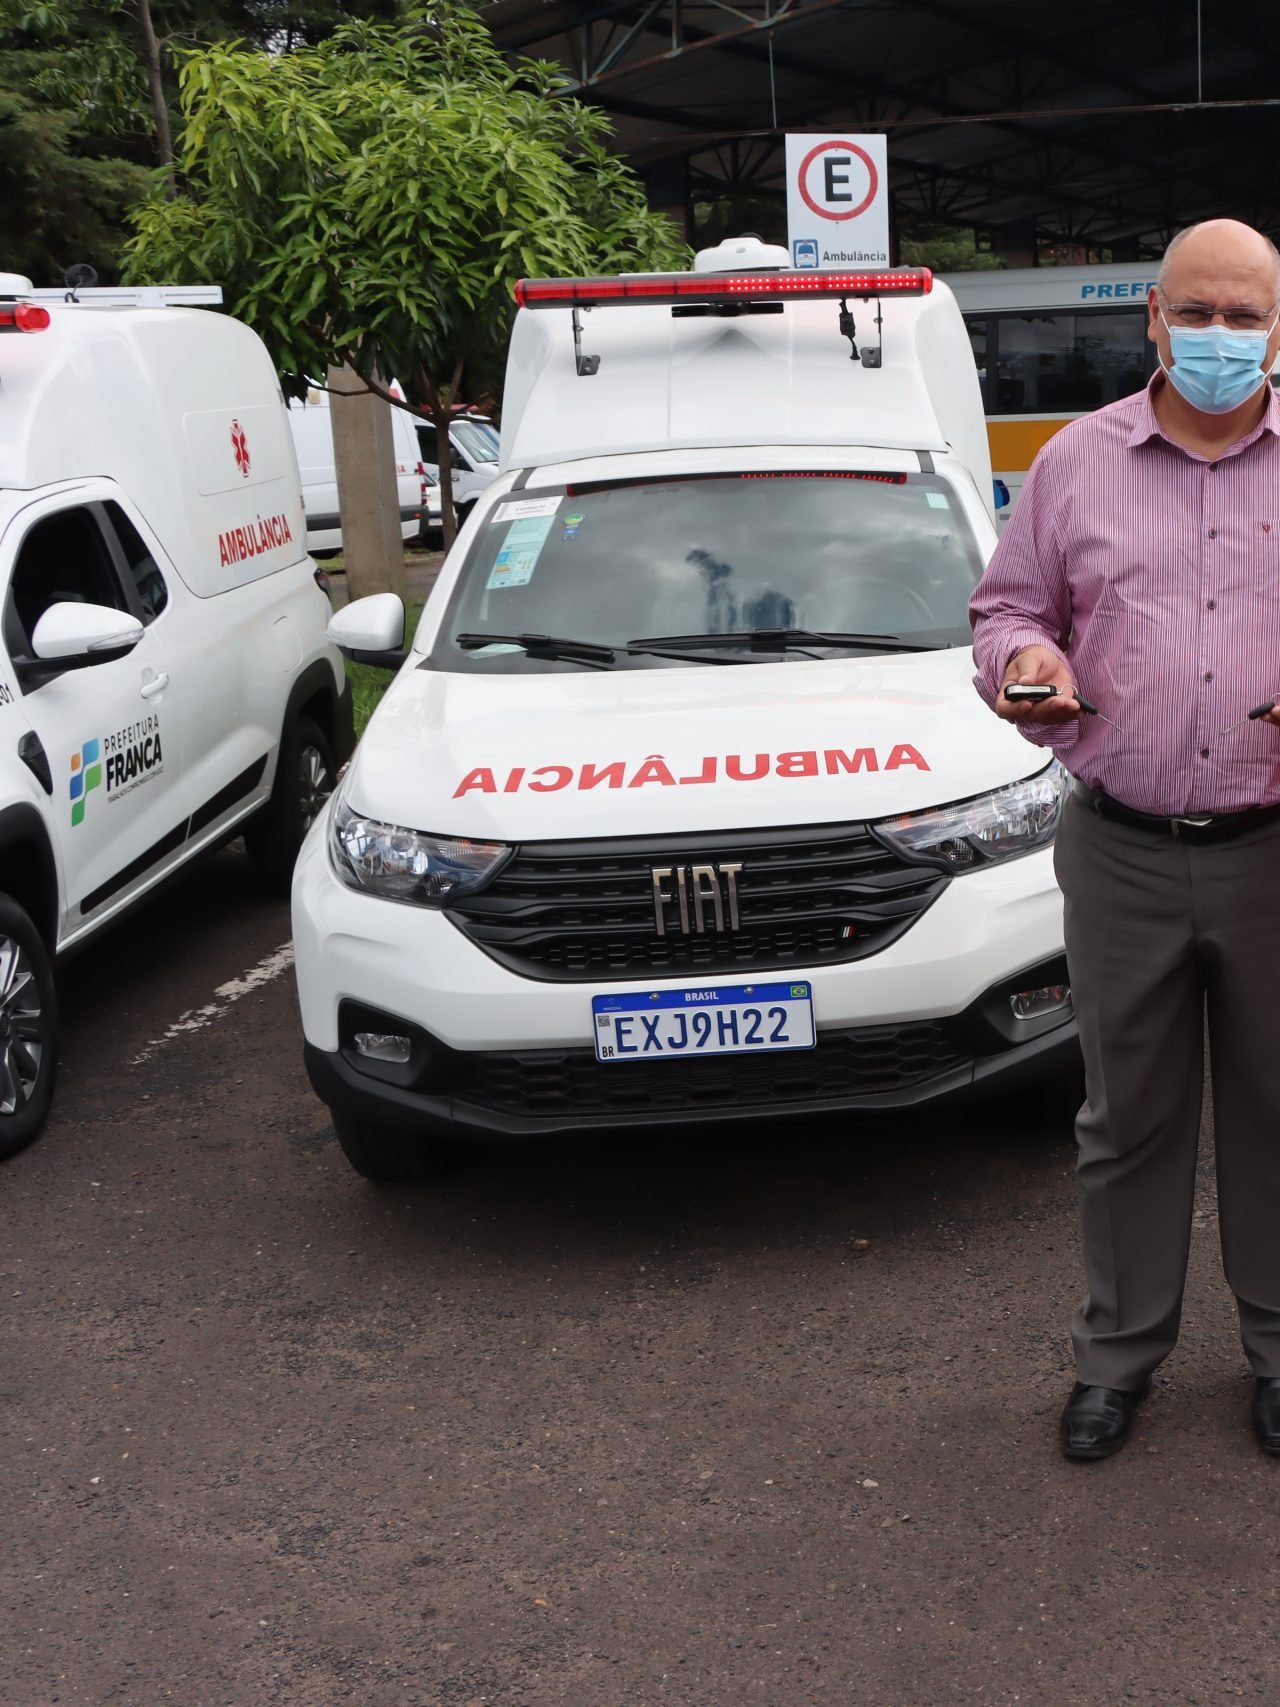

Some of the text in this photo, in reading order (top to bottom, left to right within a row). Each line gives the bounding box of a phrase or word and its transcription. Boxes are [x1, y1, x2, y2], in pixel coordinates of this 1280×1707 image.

[824, 157, 852, 202] E
[823, 251, 887, 262] Ambulância
[218, 513, 292, 567] AMBULÂNCIA
[104, 714, 159, 755] PREFEITURA
[106, 733, 162, 792] FRANCA
[652, 863, 743, 936] FIAT
[685, 991, 719, 1002] BRASIL
[602, 1045, 614, 1058] BR
[615, 1006, 790, 1053] EXJ9H22
